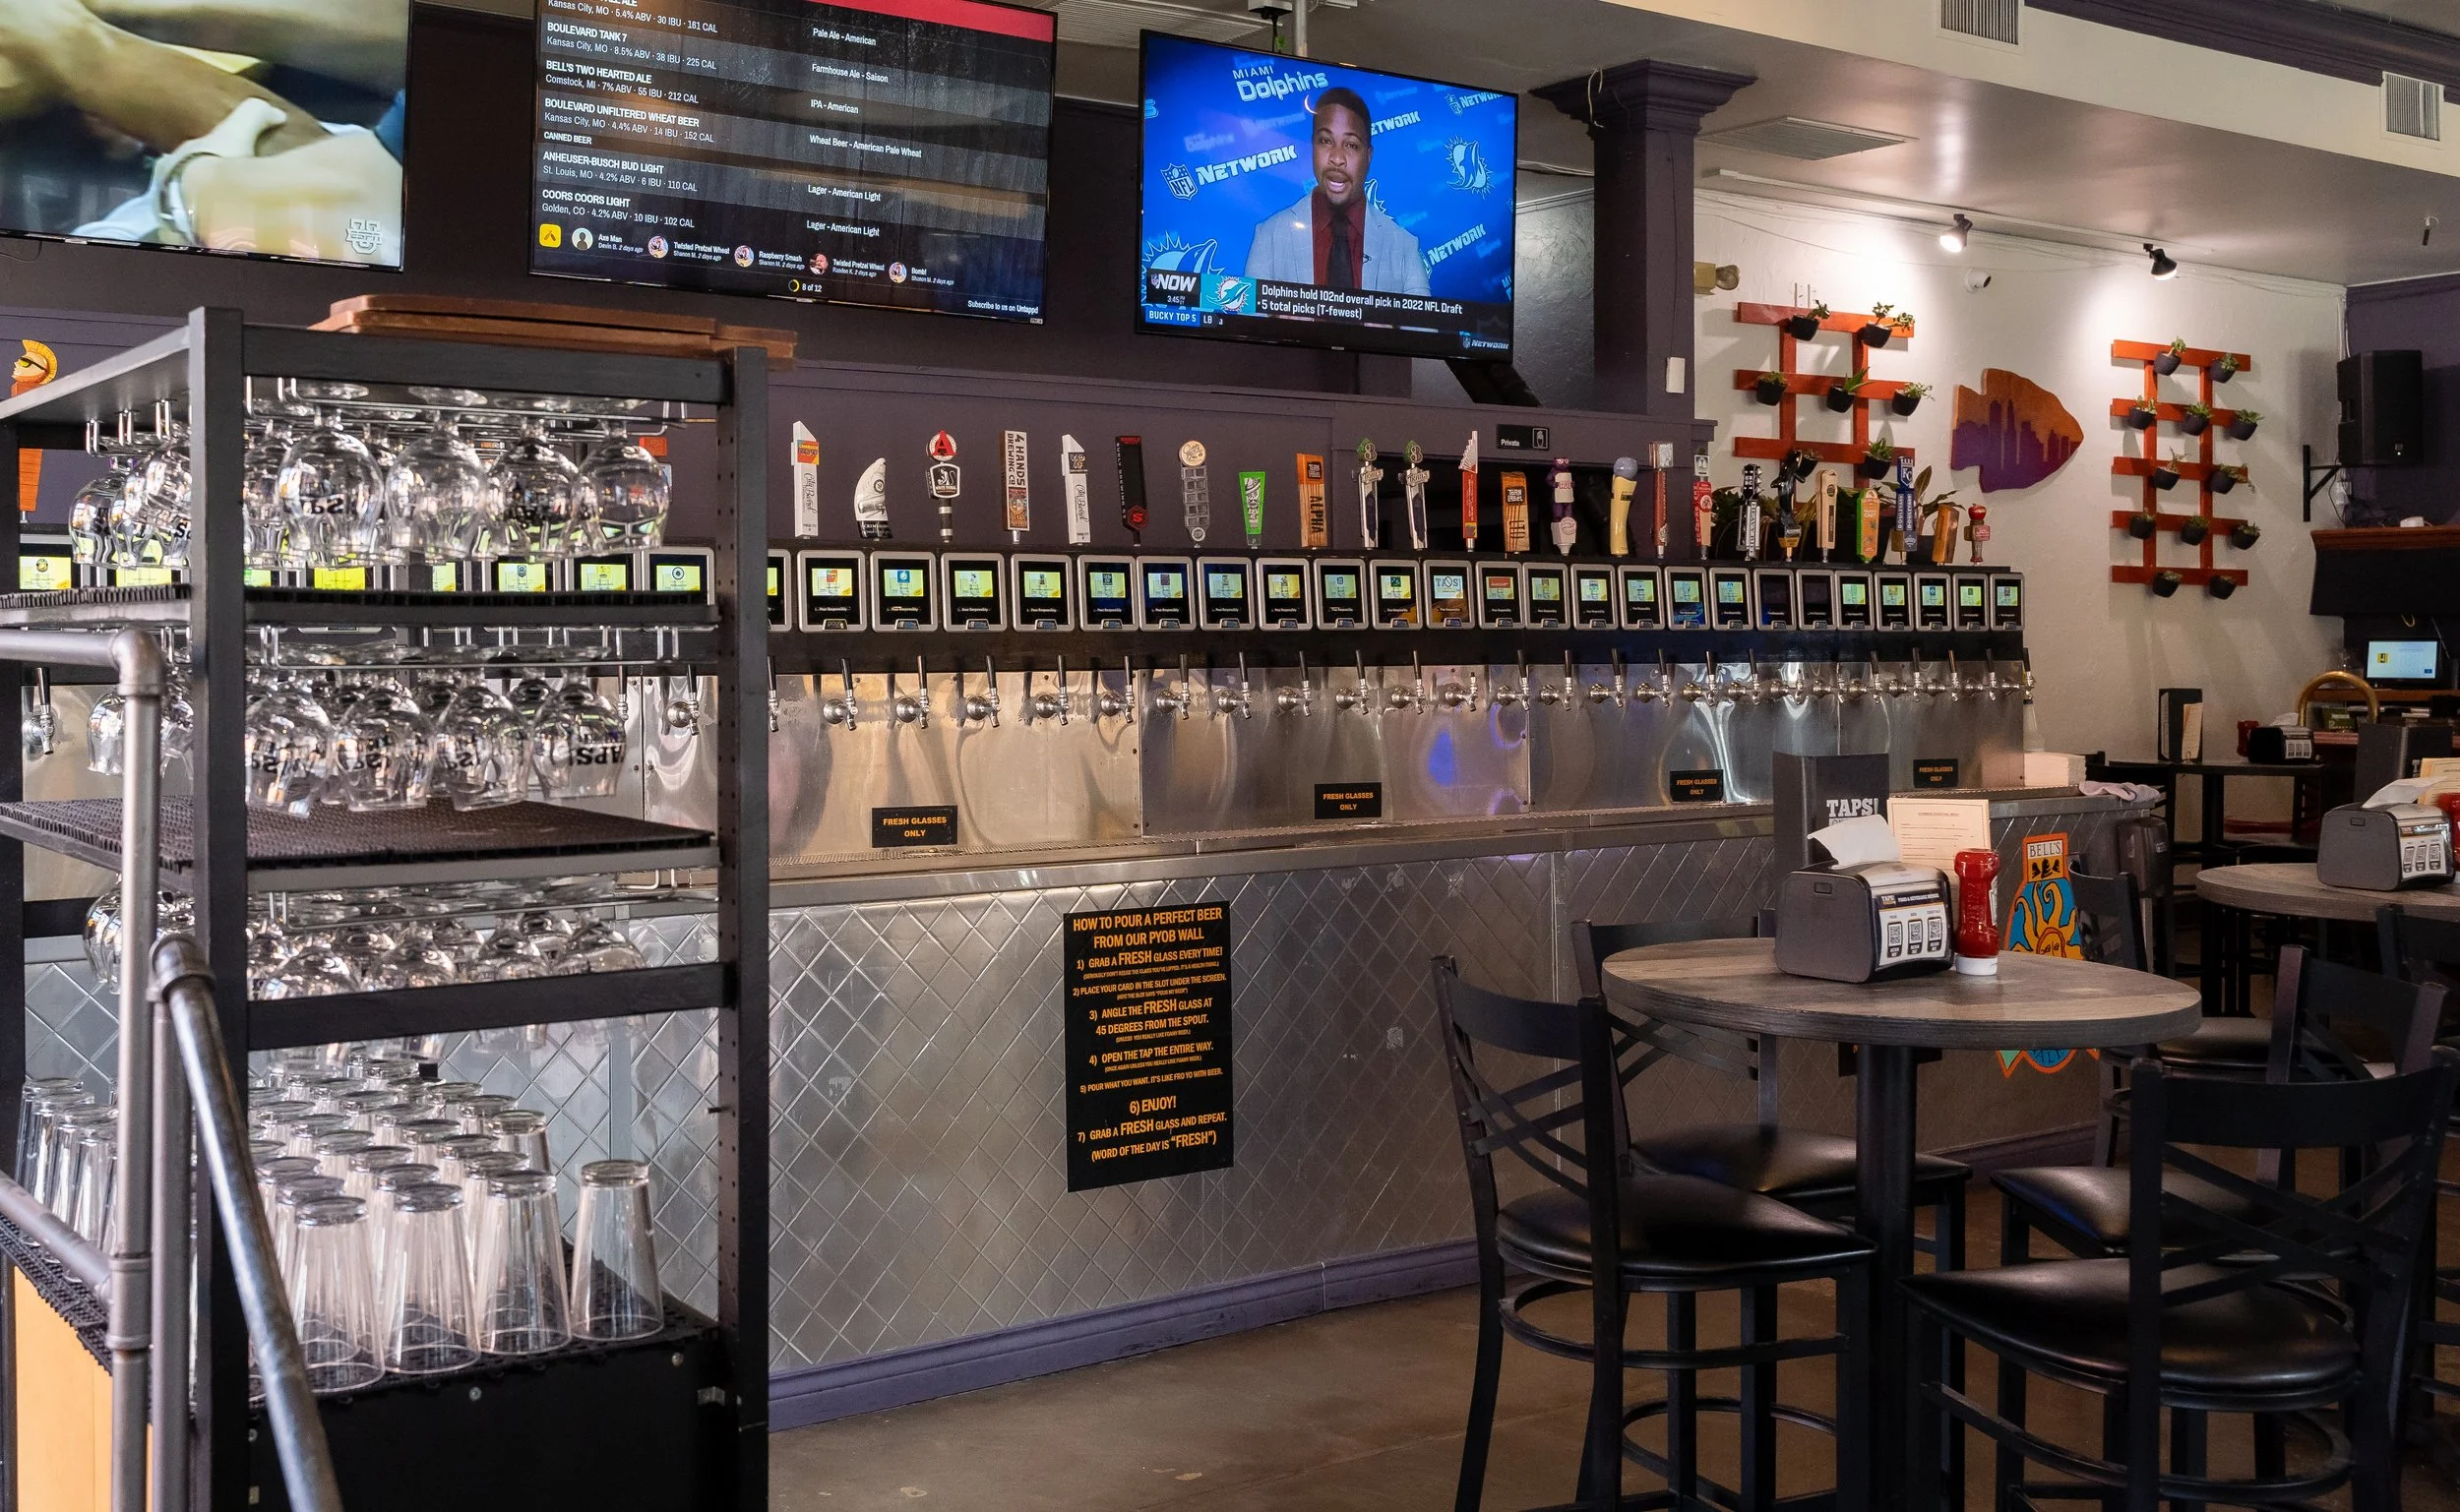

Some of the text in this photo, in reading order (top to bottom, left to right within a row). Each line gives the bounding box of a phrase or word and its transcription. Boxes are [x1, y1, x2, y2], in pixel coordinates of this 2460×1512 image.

[548, 23, 627, 42] BOULEVARD TANK 7
[813, 28, 876, 45] Pale Ale American
[547, 36, 716, 69] Kansas City, MO 8.5% ABV 38 IBU 225 CAL
[546, 60, 651, 84] BELL'S TWO HEARTED ALE
[813, 64, 888, 83] Farmhouse Ale Saison
[1233, 66, 1273, 79] MIAMI
[1237, 71, 1328, 101] Dolphins
[545, 98, 699, 127] BOULEVARD UNFILTERED WHEAT BEER
[811, 99, 858, 113] IPA American
[1371, 111, 1421, 136] ETWORK
[544, 132, 591, 145] CANNED BEER
[810, 135, 922, 157] Wheat Beer American Pale Wheat
[543, 151, 664, 174] ANHEUSER-BUSCH BUD LIGHT
[1170, 145, 1298, 196] NFL NETWORK
[543, 190, 630, 208] COORS COORS LIGHT
[808, 185, 881, 202] Lager American Light
[807, 220, 880, 237] Lager American Light
[1428, 223, 1486, 266] NETWORK
[1156, 273, 1197, 292] NOW
[968, 300, 994, 310] Subscribe
[1016, 305, 1038, 315] Untappd
[1262, 284, 1462, 314] Dolphins hold 102nd overall pick in 2022 NFL Draft
[1149, 311, 1174, 320] BUCKY
[1177, 313, 1190, 322] TOP
[1261, 300, 1362, 320] 5 total picks (T-fewest)
[1016, 447, 1025, 486] HANDS
[1310, 496, 1323, 533] ALPHA
[1826, 798, 1878, 817] TAPS!
[2030, 842, 2060, 857] BELL'S
[1074, 908, 1222, 932] HOW TO POUR A PERFECT BEER
[1094, 928, 1204, 948] FROM OUR PYOB WALL
[1077, 946, 1222, 970] 1) GRAB A FRESH GLASS EVERY TIME!
[1089, 998, 1212, 1021] 3) ANGLE THE FRESH GLASS AT
[1096, 1014, 1208, 1035] 45 DEGREES FROM THE SPOUT.
[1089, 1042, 1213, 1065] 4) OPEN THE TAP THE ENTIRE WAY.
[1130, 1096, 1176, 1116] 6) ENJOY!
[1077, 1113, 1227, 1143] 7) GRAB A FRESH GLASS AND REPEAT.
[1091, 1148, 1117, 1162] (WORD
[1120, 1146, 1130, 1156] OF
[1132, 1144, 1143, 1154] THE
[1146, 1141, 1160, 1152] DAY
[1162, 1140, 1169, 1150] IS
